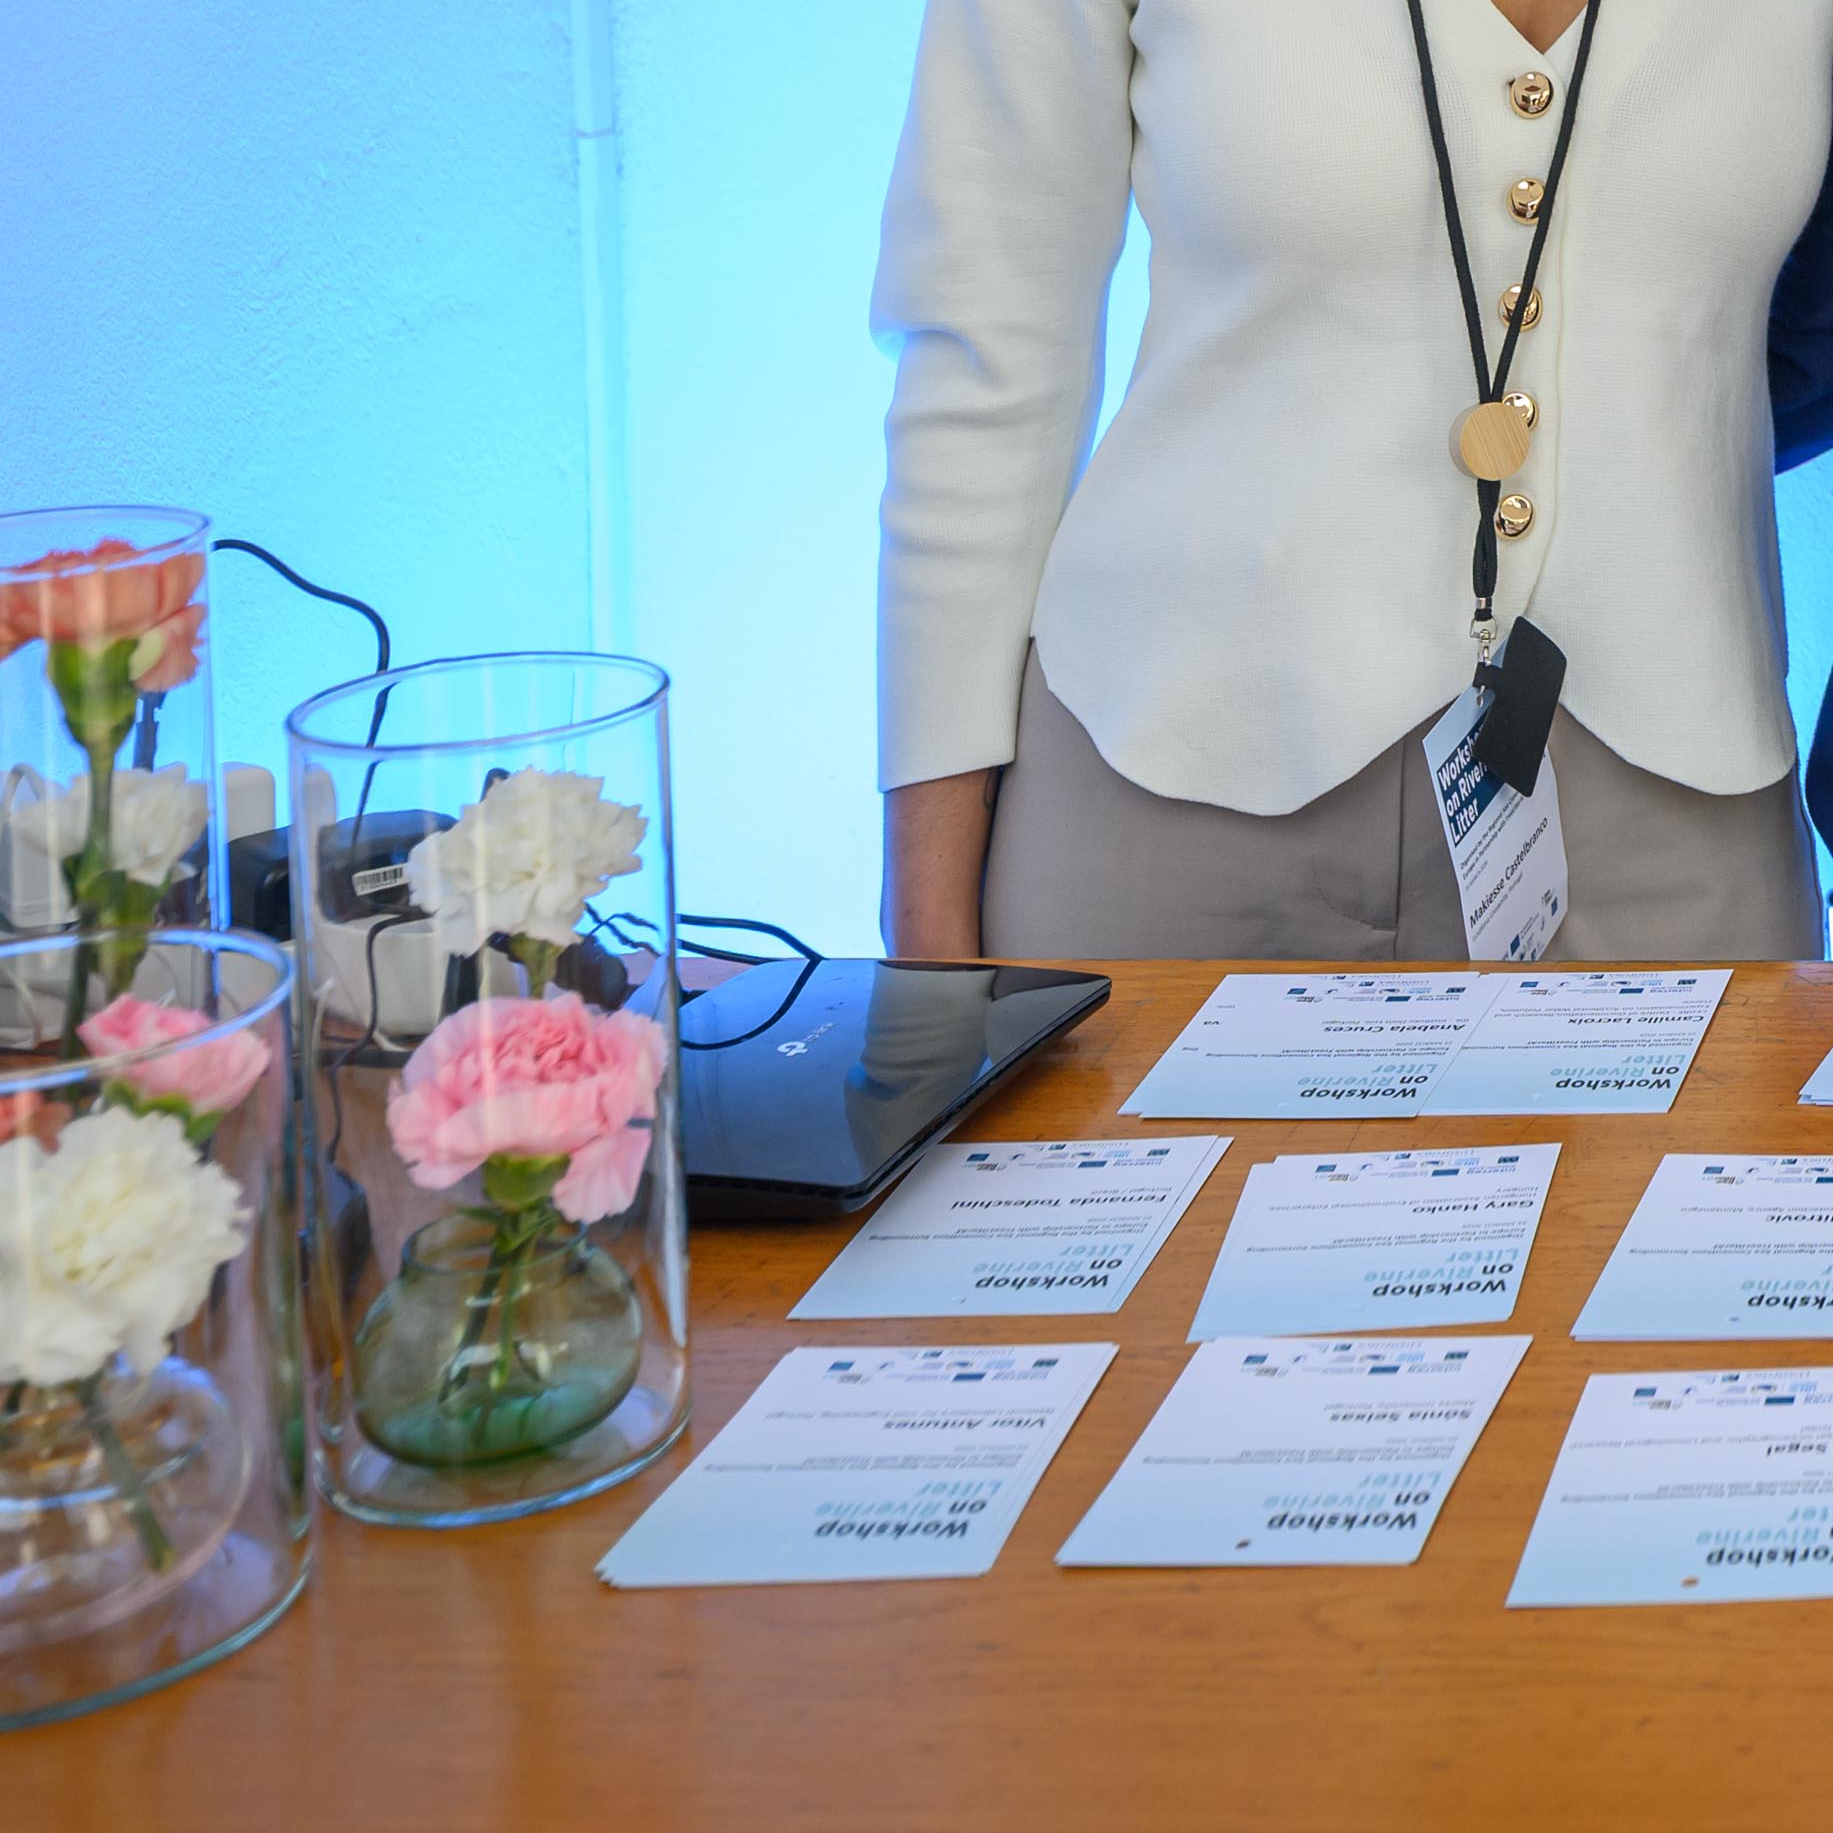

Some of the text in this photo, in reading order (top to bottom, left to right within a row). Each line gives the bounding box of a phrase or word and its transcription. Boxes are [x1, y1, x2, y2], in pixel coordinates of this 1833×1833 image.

[1446, 791, 1460, 817] on
[1451, 798, 1478, 843] Litter
[1470, 878, 1505, 929] Makiesse
[1504, 817, 1548, 881] Castelbranco
[1638, 1015, 1703, 1023] Camille
[1324, 1025, 1466, 1034] Anabela Cruces
[1622, 1055, 1687, 1066] Litter
[1372, 1063, 1438, 1075] Litter
[1550, 1067, 1679, 1079] on Riverine
[1297, 1076, 1428, 1087] on Riverine
[1556, 1078, 1671, 1090] Workshop
[1300, 1087, 1417, 1099] Workshop
[951, 1194, 1167, 1209] Fernanda Todeschini
[1412, 1200, 1534, 1214] Gary Hanko
[1059, 1243, 1133, 1258] Litter
[1446, 1248, 1519, 1264] Litter
[973, 1258, 1122, 1276] on Riverine
[1364, 1264, 1514, 1284] on Riverine
[975, 1273, 1109, 1291] Workshop
[1372, 1280, 1506, 1299] Workshop
[1359, 1472, 1442, 1489] Litter
[949, 1498, 987, 1515] on
[1395, 1492, 1430, 1508] on
[814, 1519, 969, 1541] Workshop
[1267, 1512, 1419, 1533] Workshop
